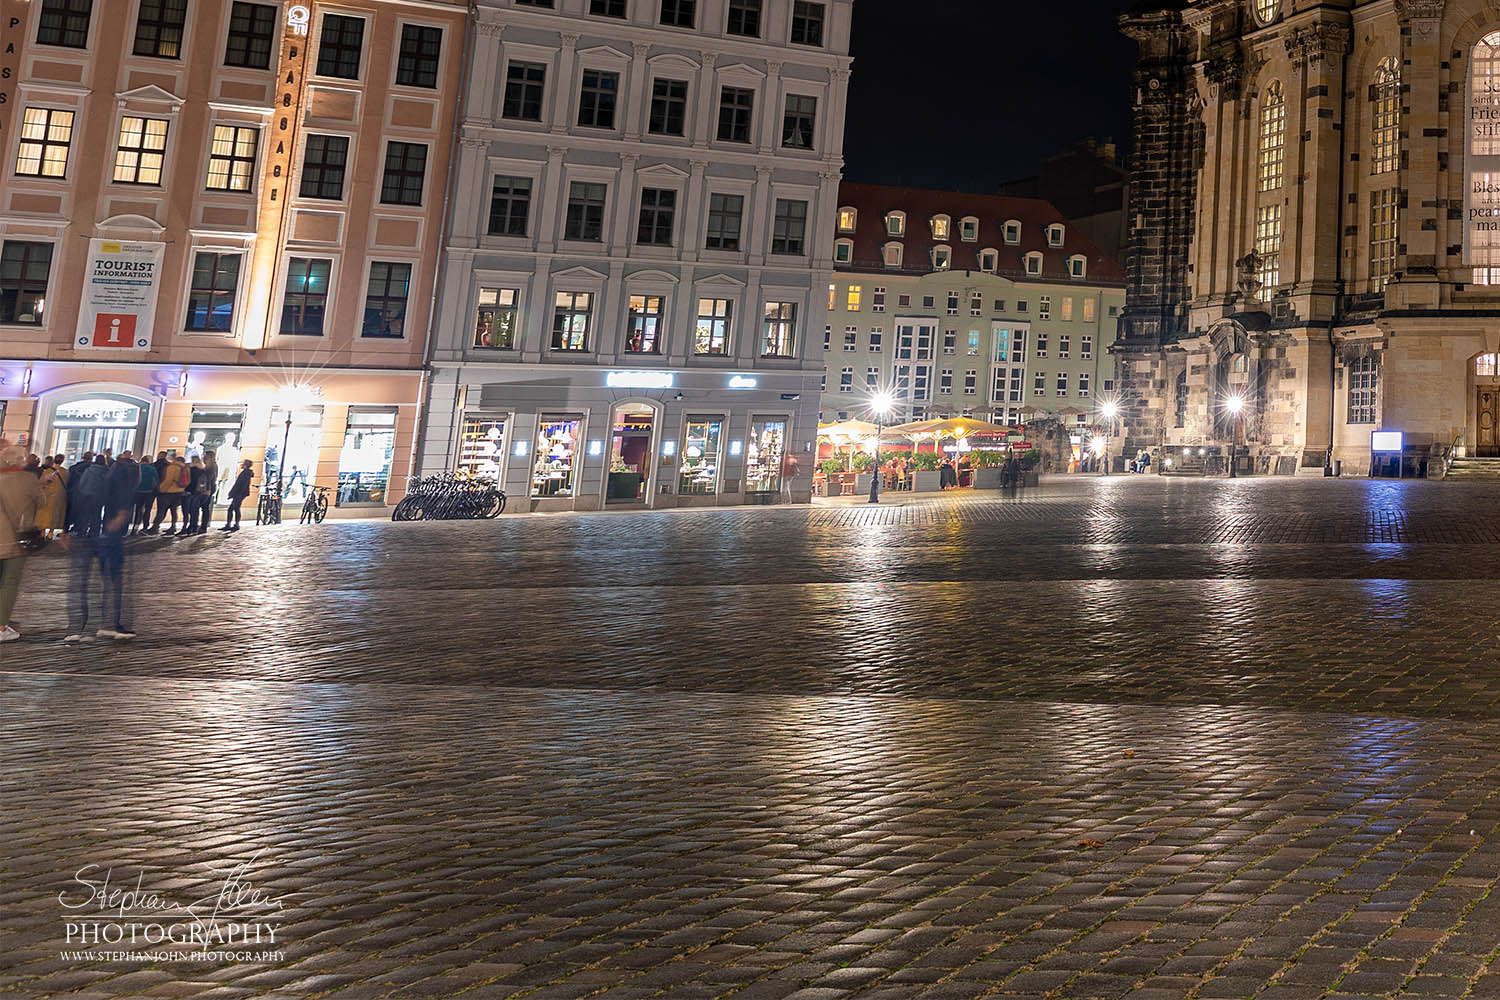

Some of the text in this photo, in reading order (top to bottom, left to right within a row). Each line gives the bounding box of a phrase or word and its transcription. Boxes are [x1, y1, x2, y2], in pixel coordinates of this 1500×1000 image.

[269, 46, 298, 201] PASSAGE
[95, 260, 155, 272] TOURIST
[93, 270, 153, 278] INFORMATION
